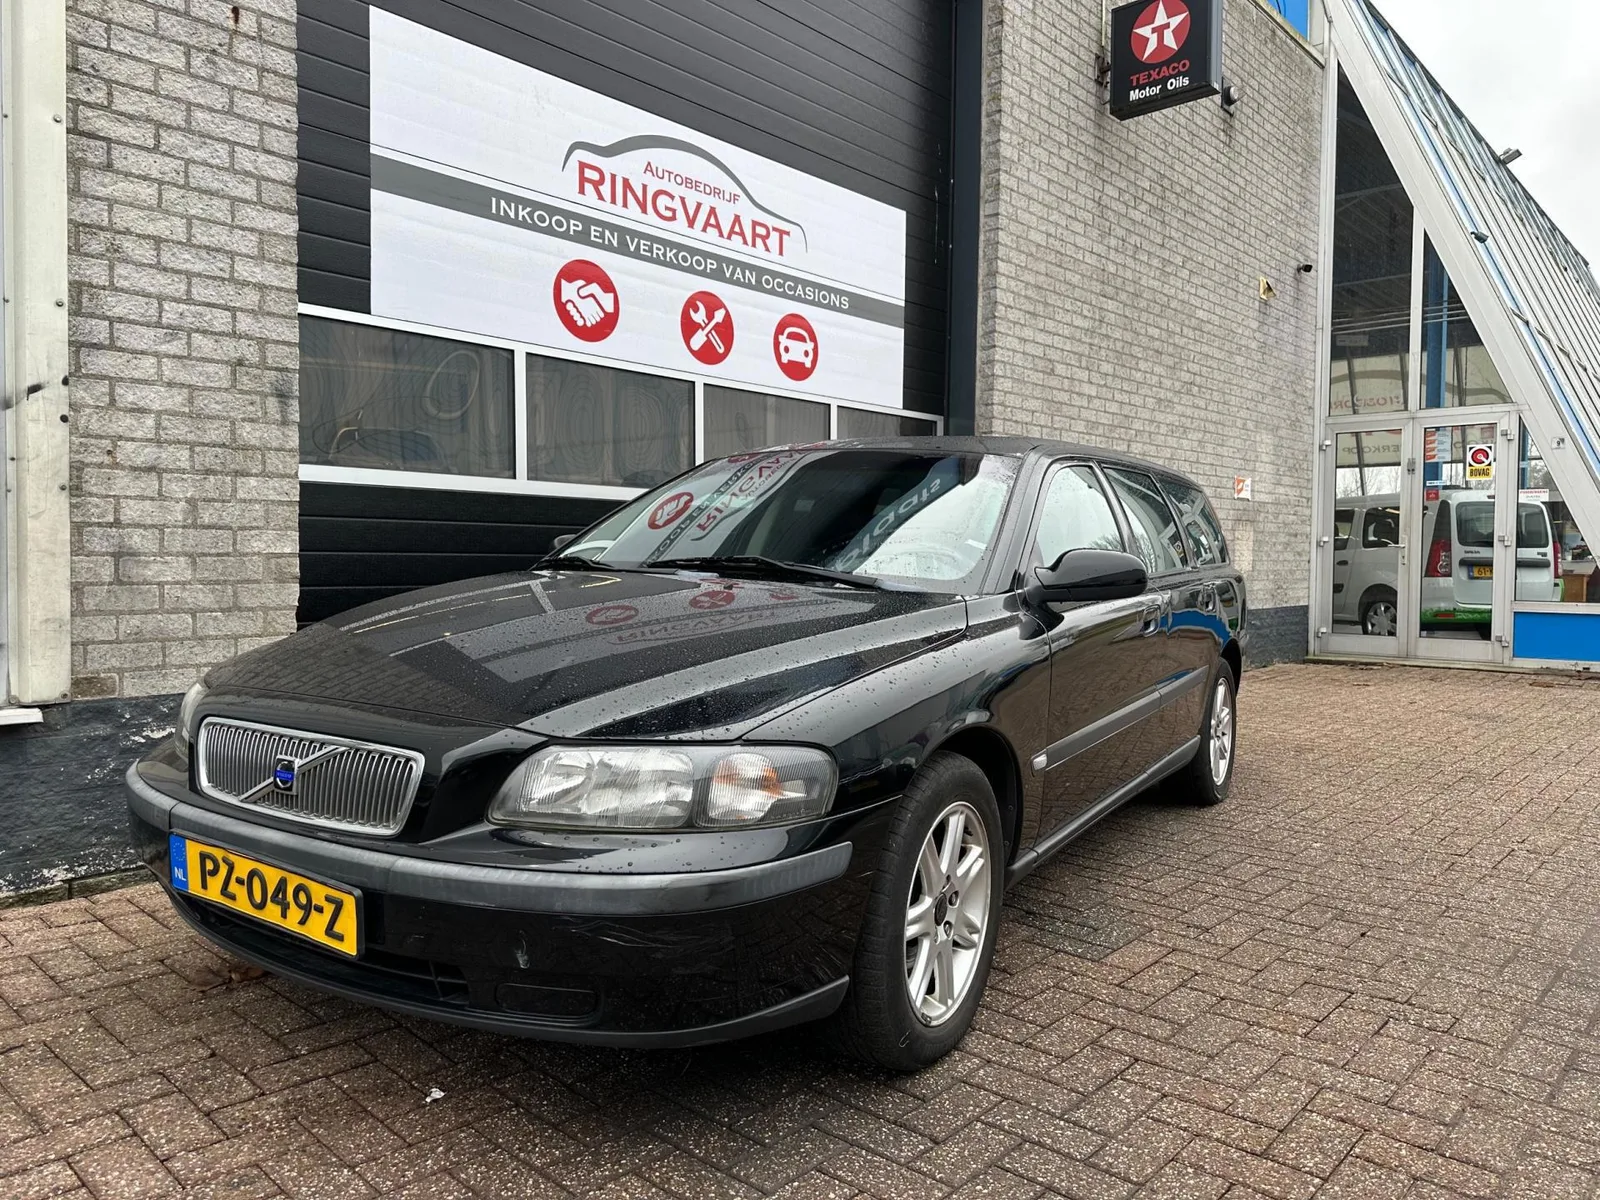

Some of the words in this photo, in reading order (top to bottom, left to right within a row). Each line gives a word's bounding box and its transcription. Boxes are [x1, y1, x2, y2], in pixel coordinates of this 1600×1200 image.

[1129, 59, 1190, 87] TEXACO
[1129, 84, 1162, 101] Motor
[1166, 76, 1190, 91] Oils
[643, 161, 741, 205] AUTOBEDRIJF
[577, 160, 791, 257] RINGVAART
[491, 197, 583, 236] INKOOP
[590, 225, 618, 248] EN
[625, 235, 717, 273] VERKOOP
[722, 263, 756, 285] VAN
[761, 275, 850, 309] OCCASIONS
[1469, 467, 1490, 477] BOVAG
[174, 866, 187, 882] NL
[199, 850, 345, 943] PZ-049-Z
